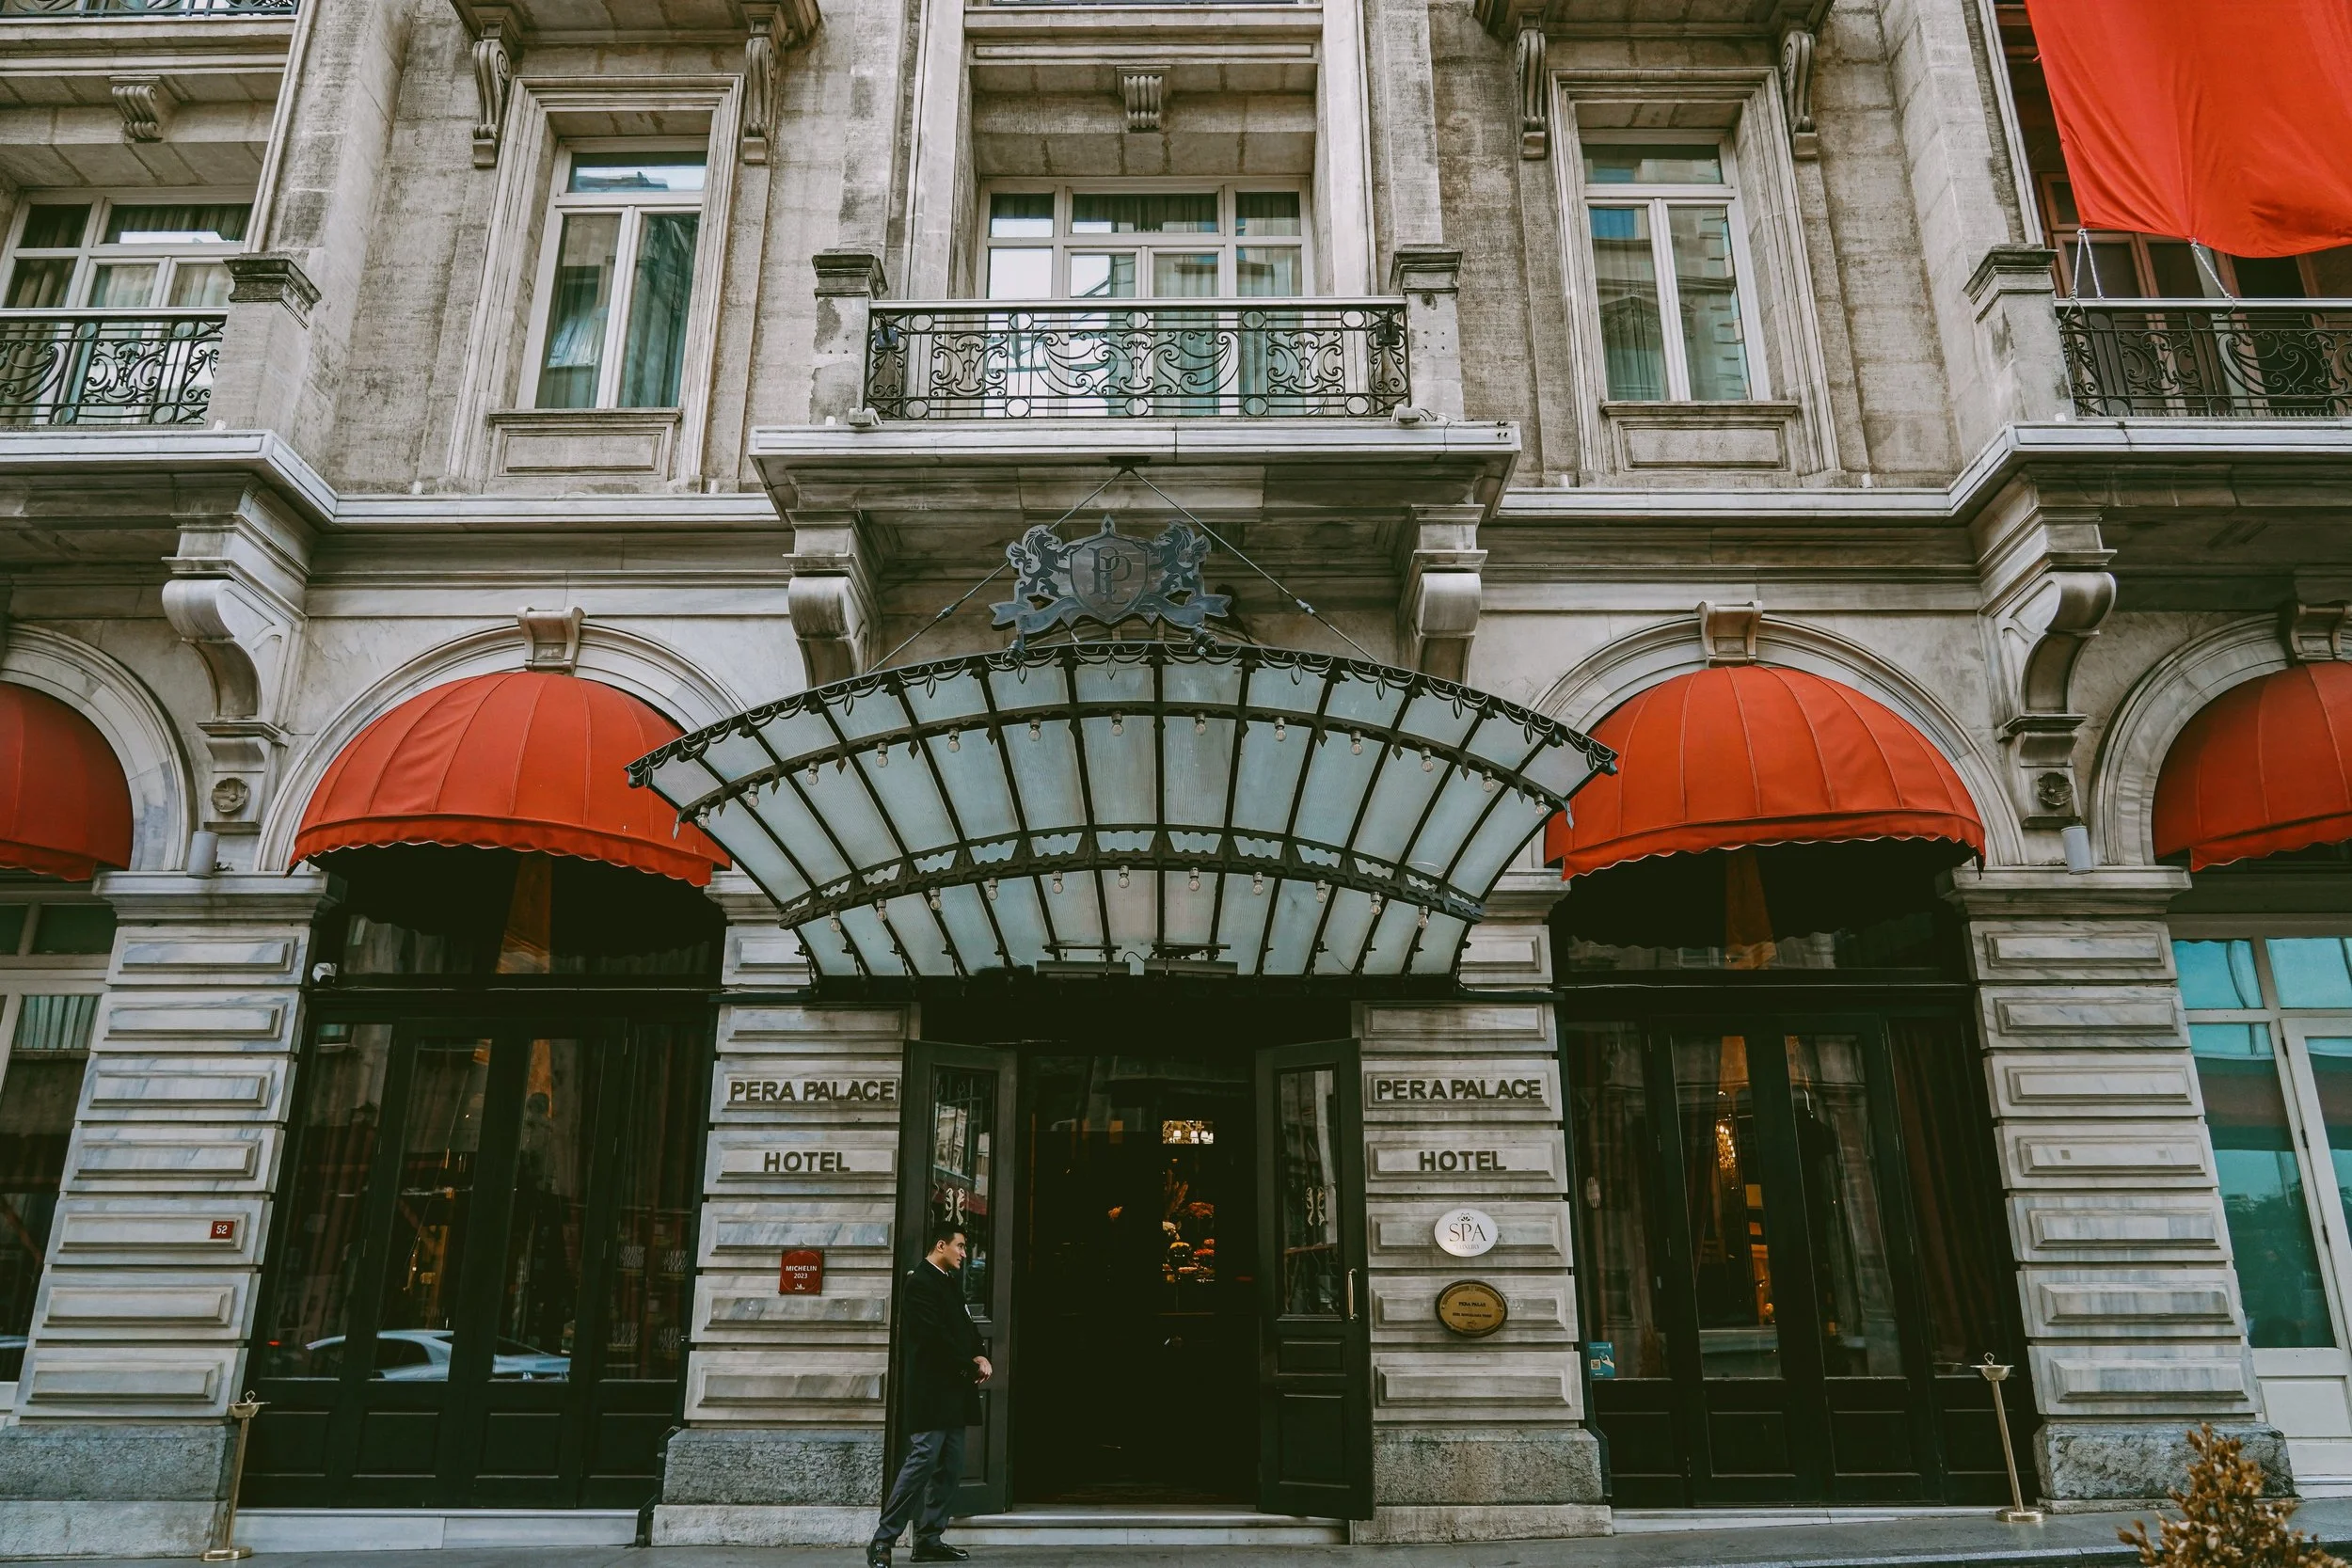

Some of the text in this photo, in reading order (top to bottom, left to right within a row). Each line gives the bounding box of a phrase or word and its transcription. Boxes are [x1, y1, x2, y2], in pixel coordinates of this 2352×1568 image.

[730, 1080, 895, 1101] PERA PALACE
[1376, 1079, 1543, 1100] PERA PALACE
[764, 1151, 850, 1172] HOTEL
[1419, 1150, 1507, 1171] HOTEL
[215, 1225, 228, 1234] 52
[1449, 1223, 1486, 1242] SPA
